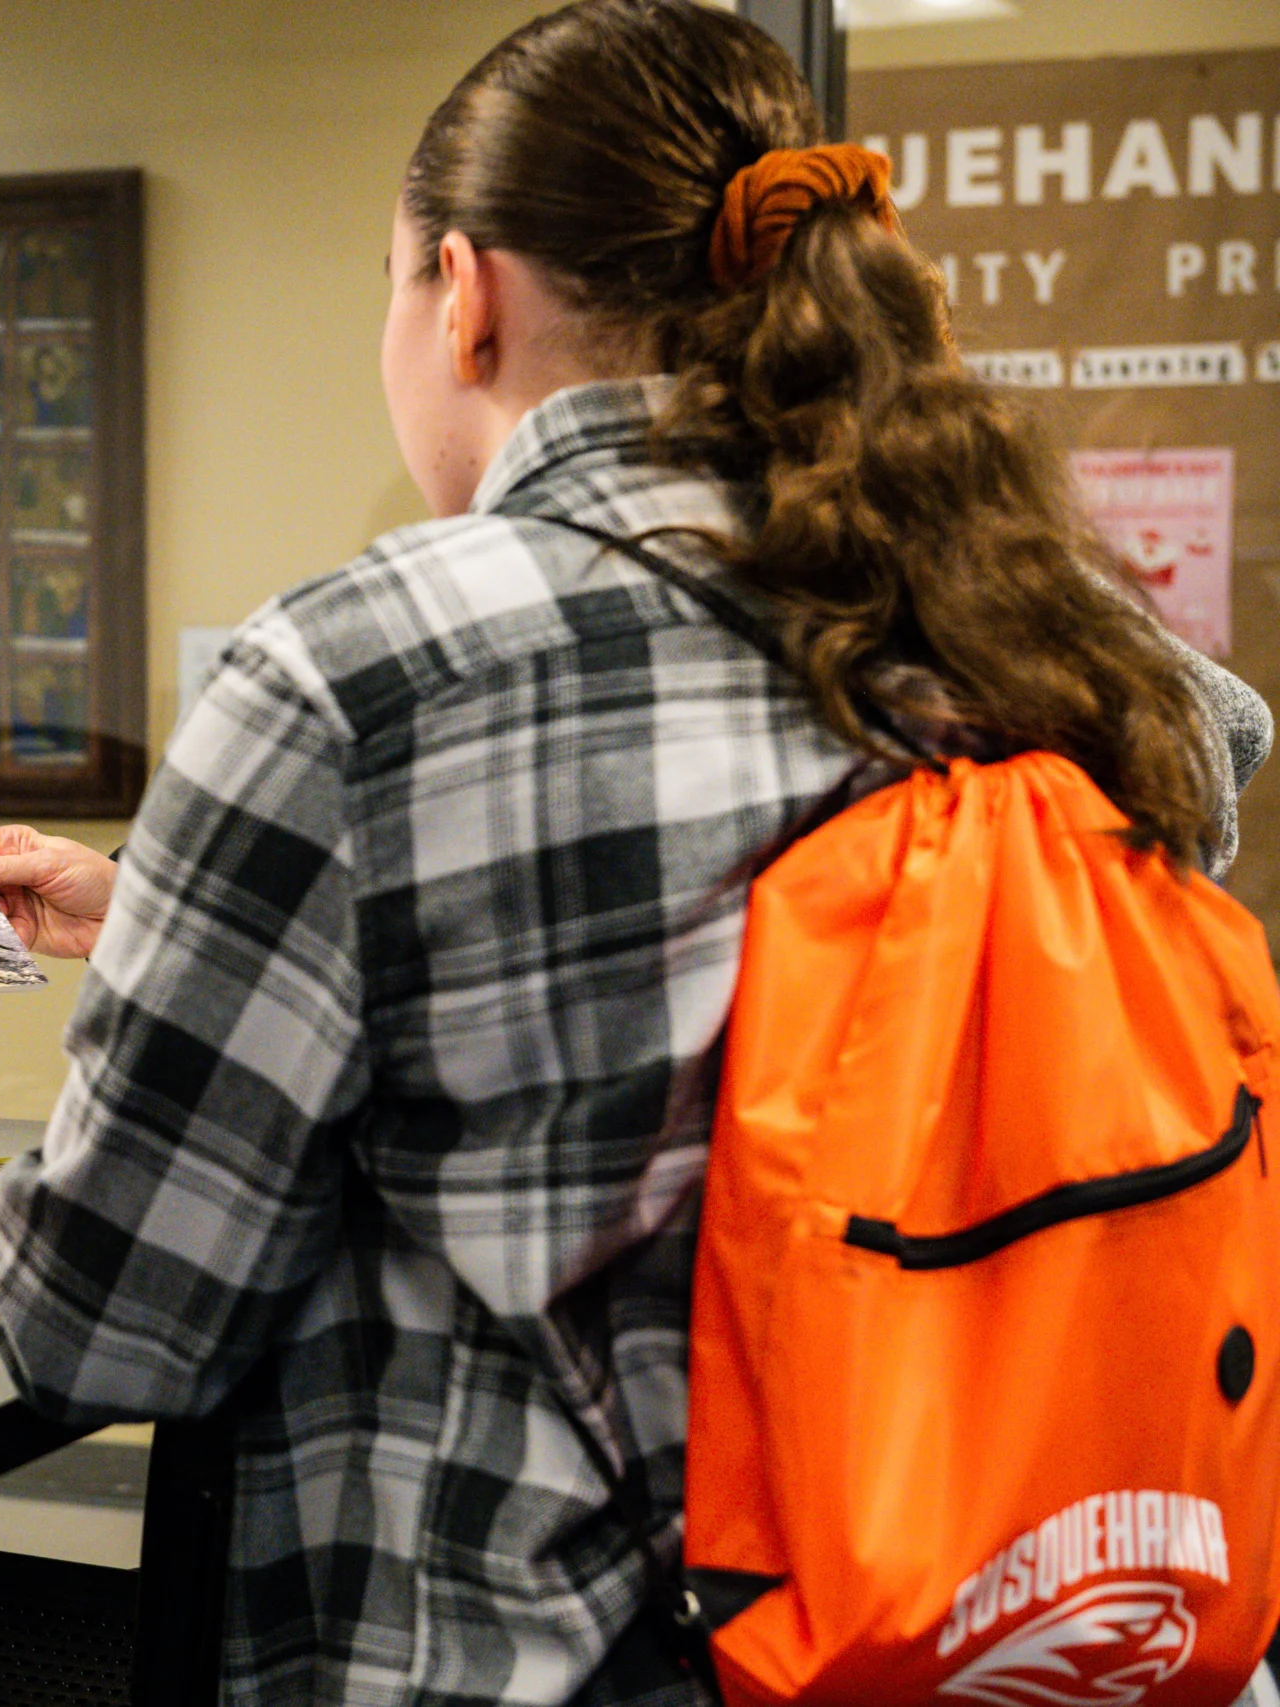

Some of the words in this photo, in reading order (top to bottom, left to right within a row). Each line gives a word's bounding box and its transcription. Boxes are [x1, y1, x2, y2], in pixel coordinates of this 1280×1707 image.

[863, 112, 1280, 212] UEHAN
[941, 249, 1066, 304] ITY
[936, 1489, 1229, 1658] SUSQUEHANNA
